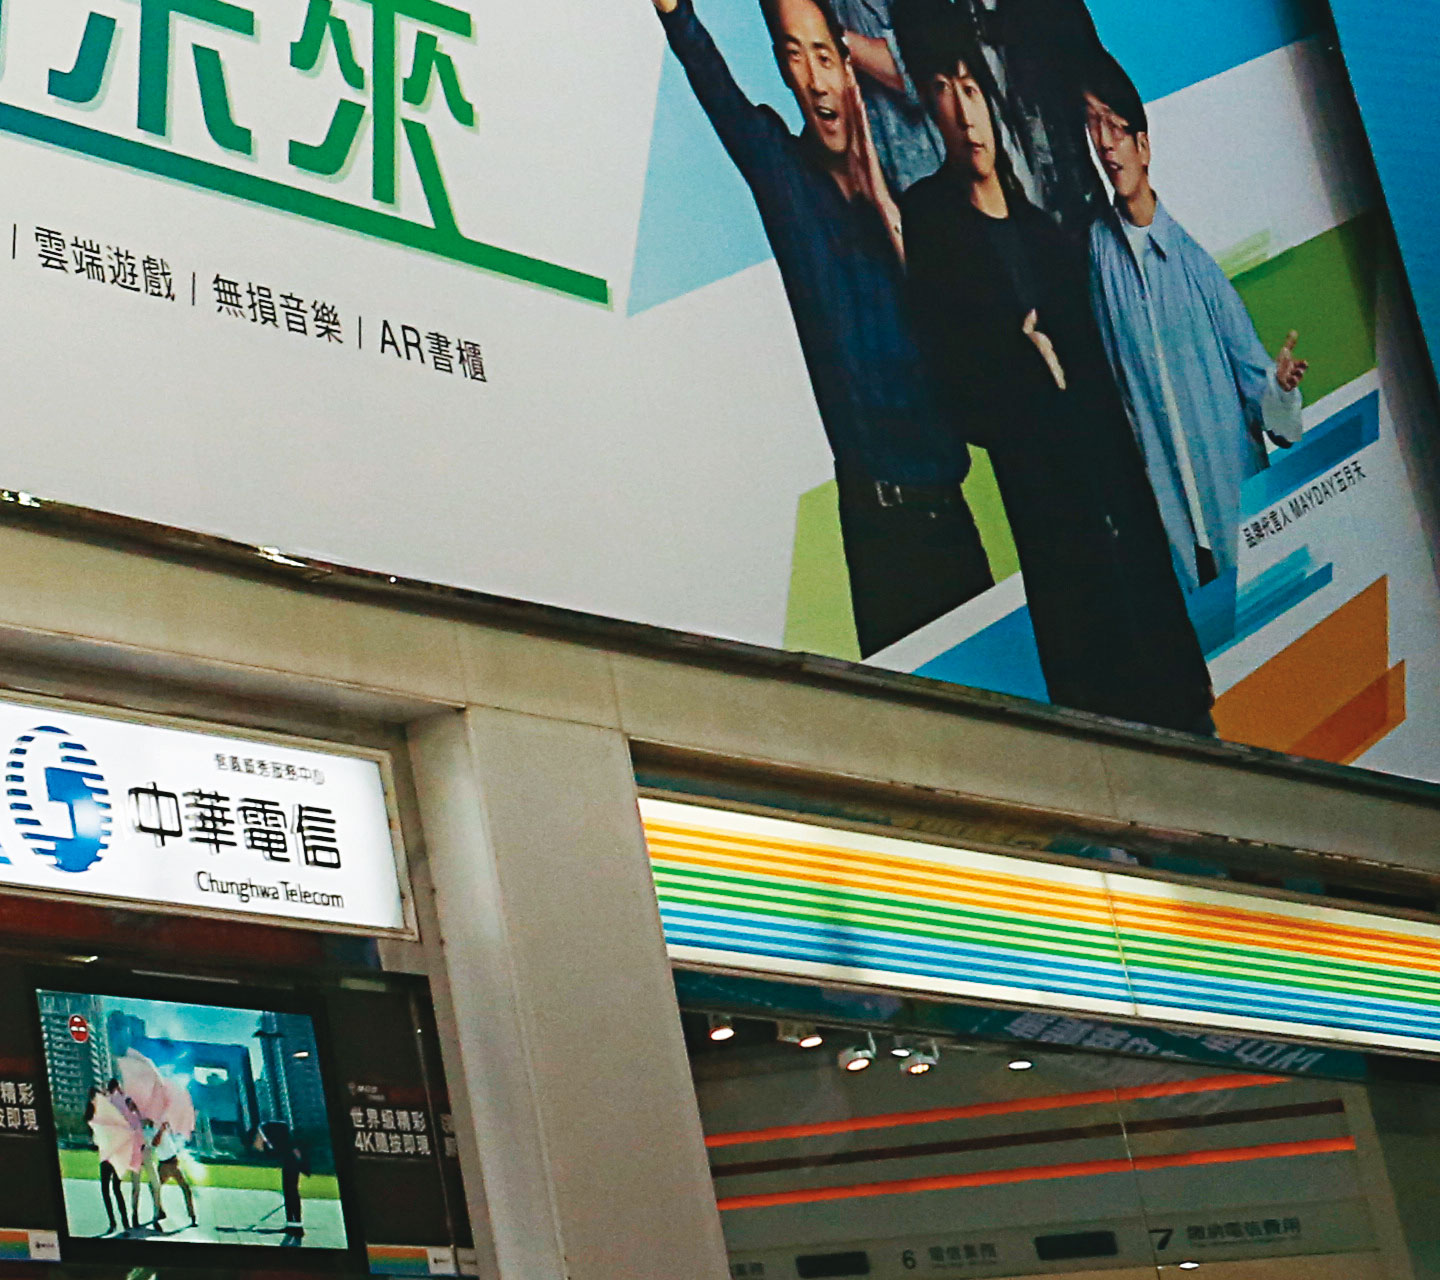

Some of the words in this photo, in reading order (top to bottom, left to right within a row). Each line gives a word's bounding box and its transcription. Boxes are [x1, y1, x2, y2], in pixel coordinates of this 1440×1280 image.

[32, 227, 175, 305] 雲端遊戲
[211, 273, 344, 345] 無損音樂
[378, 321, 487, 384] AR書櫃
[127, 780, 342, 869] 中華電信
[195, 870, 279, 903] Chunghwa
[280, 880, 344, 909] Telecom
[1148, 1227, 1174, 1251] 7
[901, 1249, 917, 1270] 6
